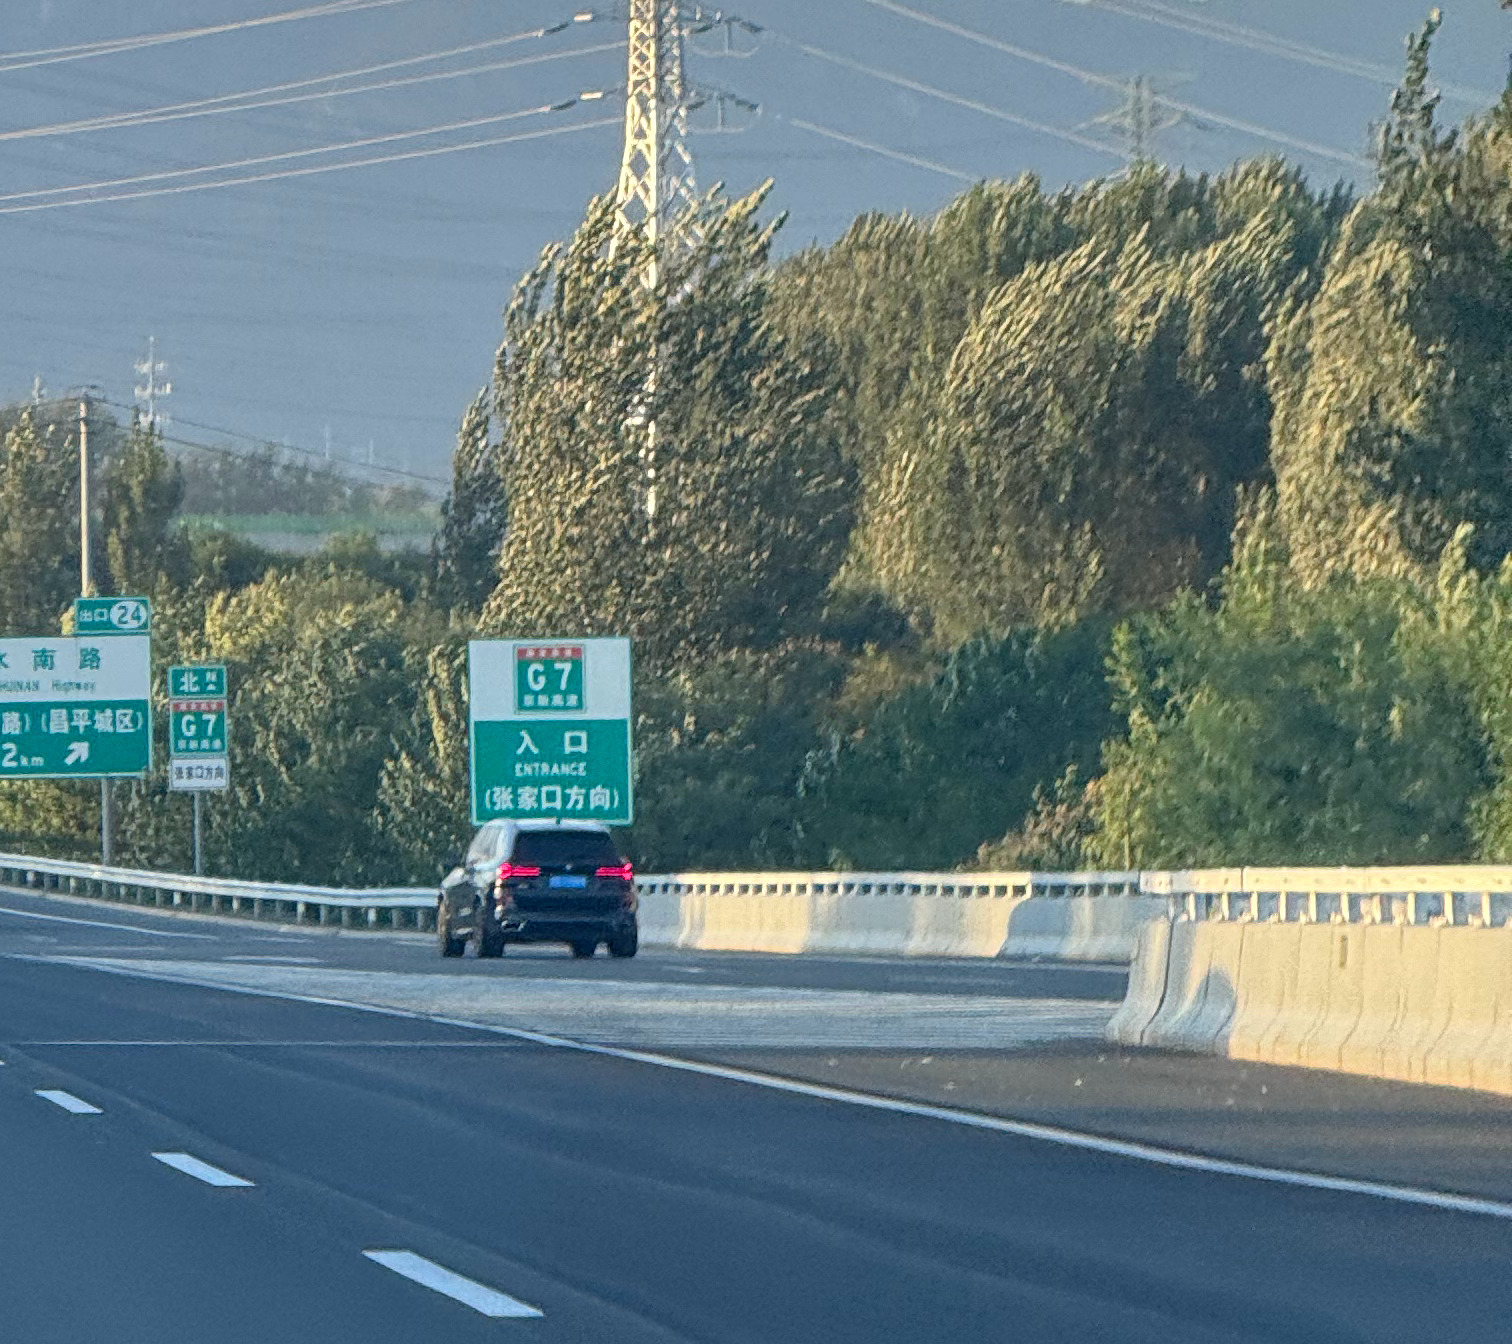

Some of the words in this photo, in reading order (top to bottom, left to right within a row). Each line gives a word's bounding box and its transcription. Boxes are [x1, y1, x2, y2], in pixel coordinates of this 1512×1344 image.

[79, 607, 109, 623] 出口
[117, 604, 142, 625] 24
[527, 662, 572, 691] G7
[181, 714, 217, 736] G7
[516, 729, 588, 754] 入口
[515, 761, 587, 777] ENTRANCE
[485, 784, 619, 811] (张家口方向)
